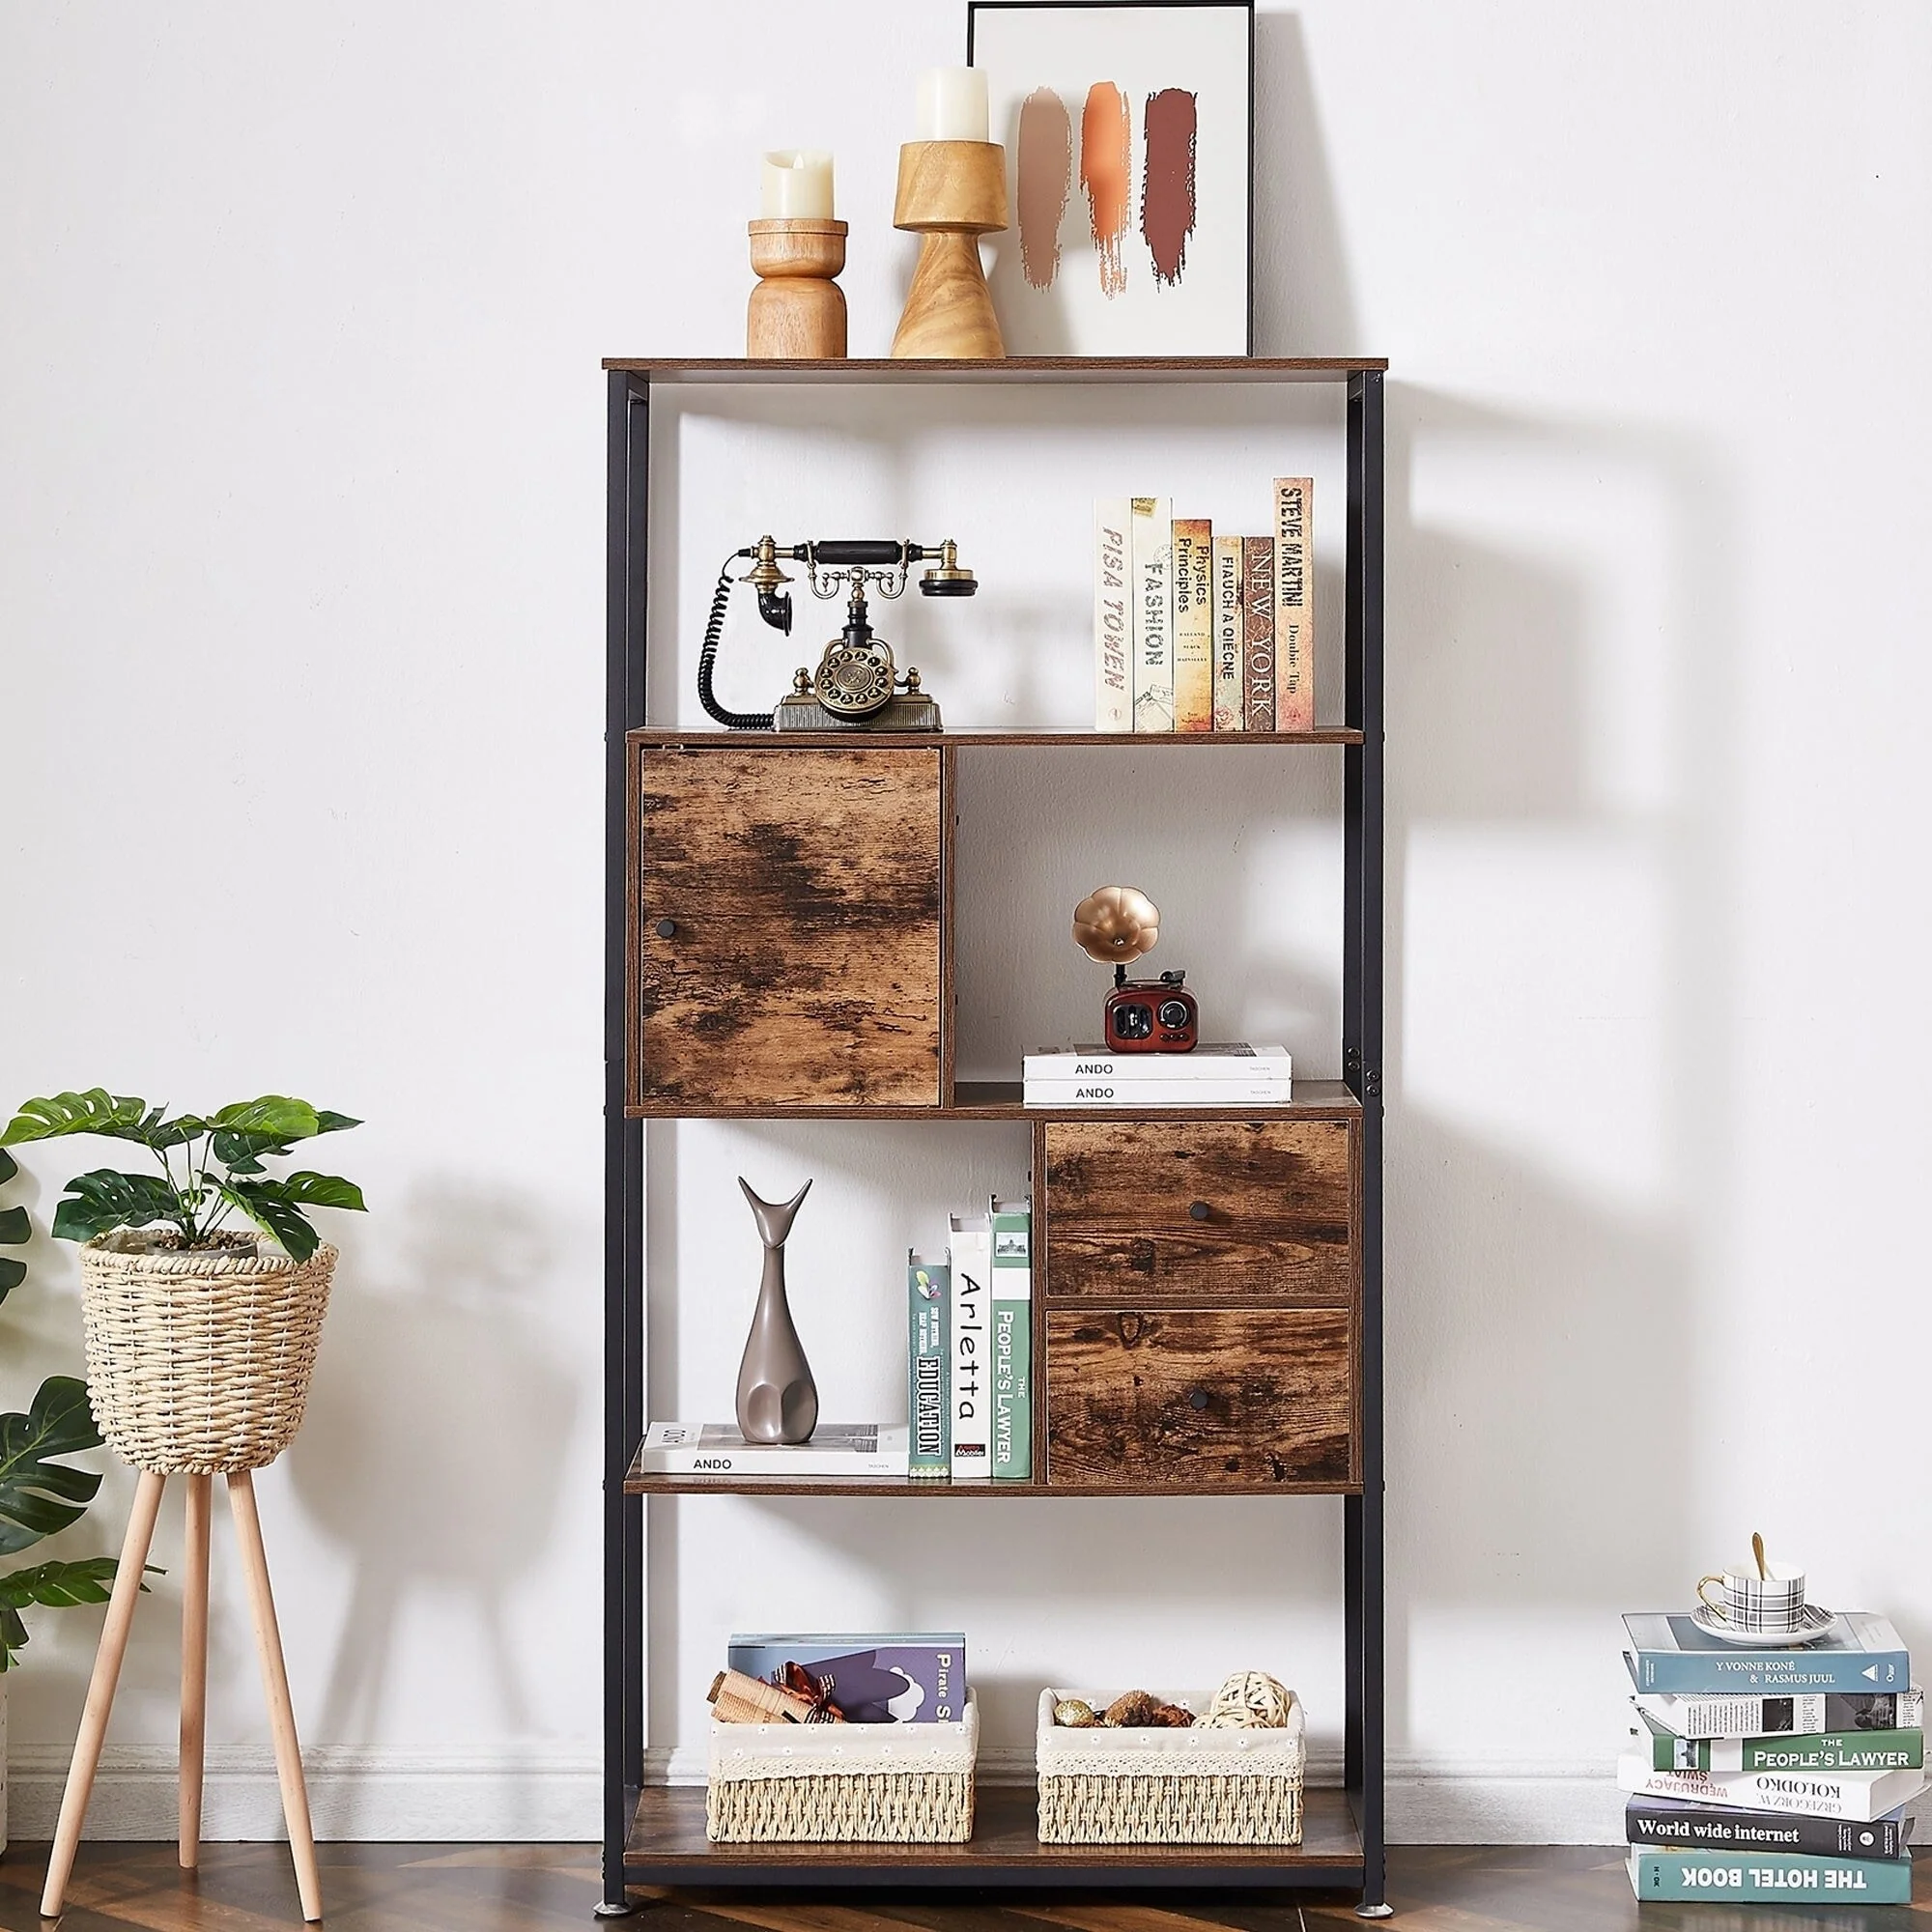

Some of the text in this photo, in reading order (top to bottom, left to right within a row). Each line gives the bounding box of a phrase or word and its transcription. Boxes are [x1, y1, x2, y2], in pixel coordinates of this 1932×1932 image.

[1102, 526, 1123, 588] PISA
[1281, 488, 1303, 608] STEVE MARTINI
[1175, 538, 1192, 614] Principles
[1196, 546, 1210, 606] Physics
[1222, 556, 1234, 611] FIAUCH
[1145, 563, 1164, 666] FASHION
[1222, 614, 1234, 624] A
[1251, 551, 1273, 717] NEW YORK
[1286, 670, 1299, 695] Tap
[1075, 1064, 1114, 1075] ANDO
[1075, 1088, 1114, 1098] ANDO
[958, 1272, 982, 1420] Arletta
[918, 1356, 940, 1456] EDUCATION
[997, 1311, 1014, 1463] PEOPLE'S LAWYER
[1017, 1377, 1026, 1399] THE
[693, 1459, 731, 1469] ANDO
[936, 1654, 952, 1723] Pirate S
[1749, 1675, 1835, 1685] & RASMUS JUUL
[1754, 1750, 1909, 1767] PEOPLE'S LAWYER
[1637, 1818, 1800, 1843] World wide internet
[1681, 1867, 1867, 1889] THE HOTEL BOOK
